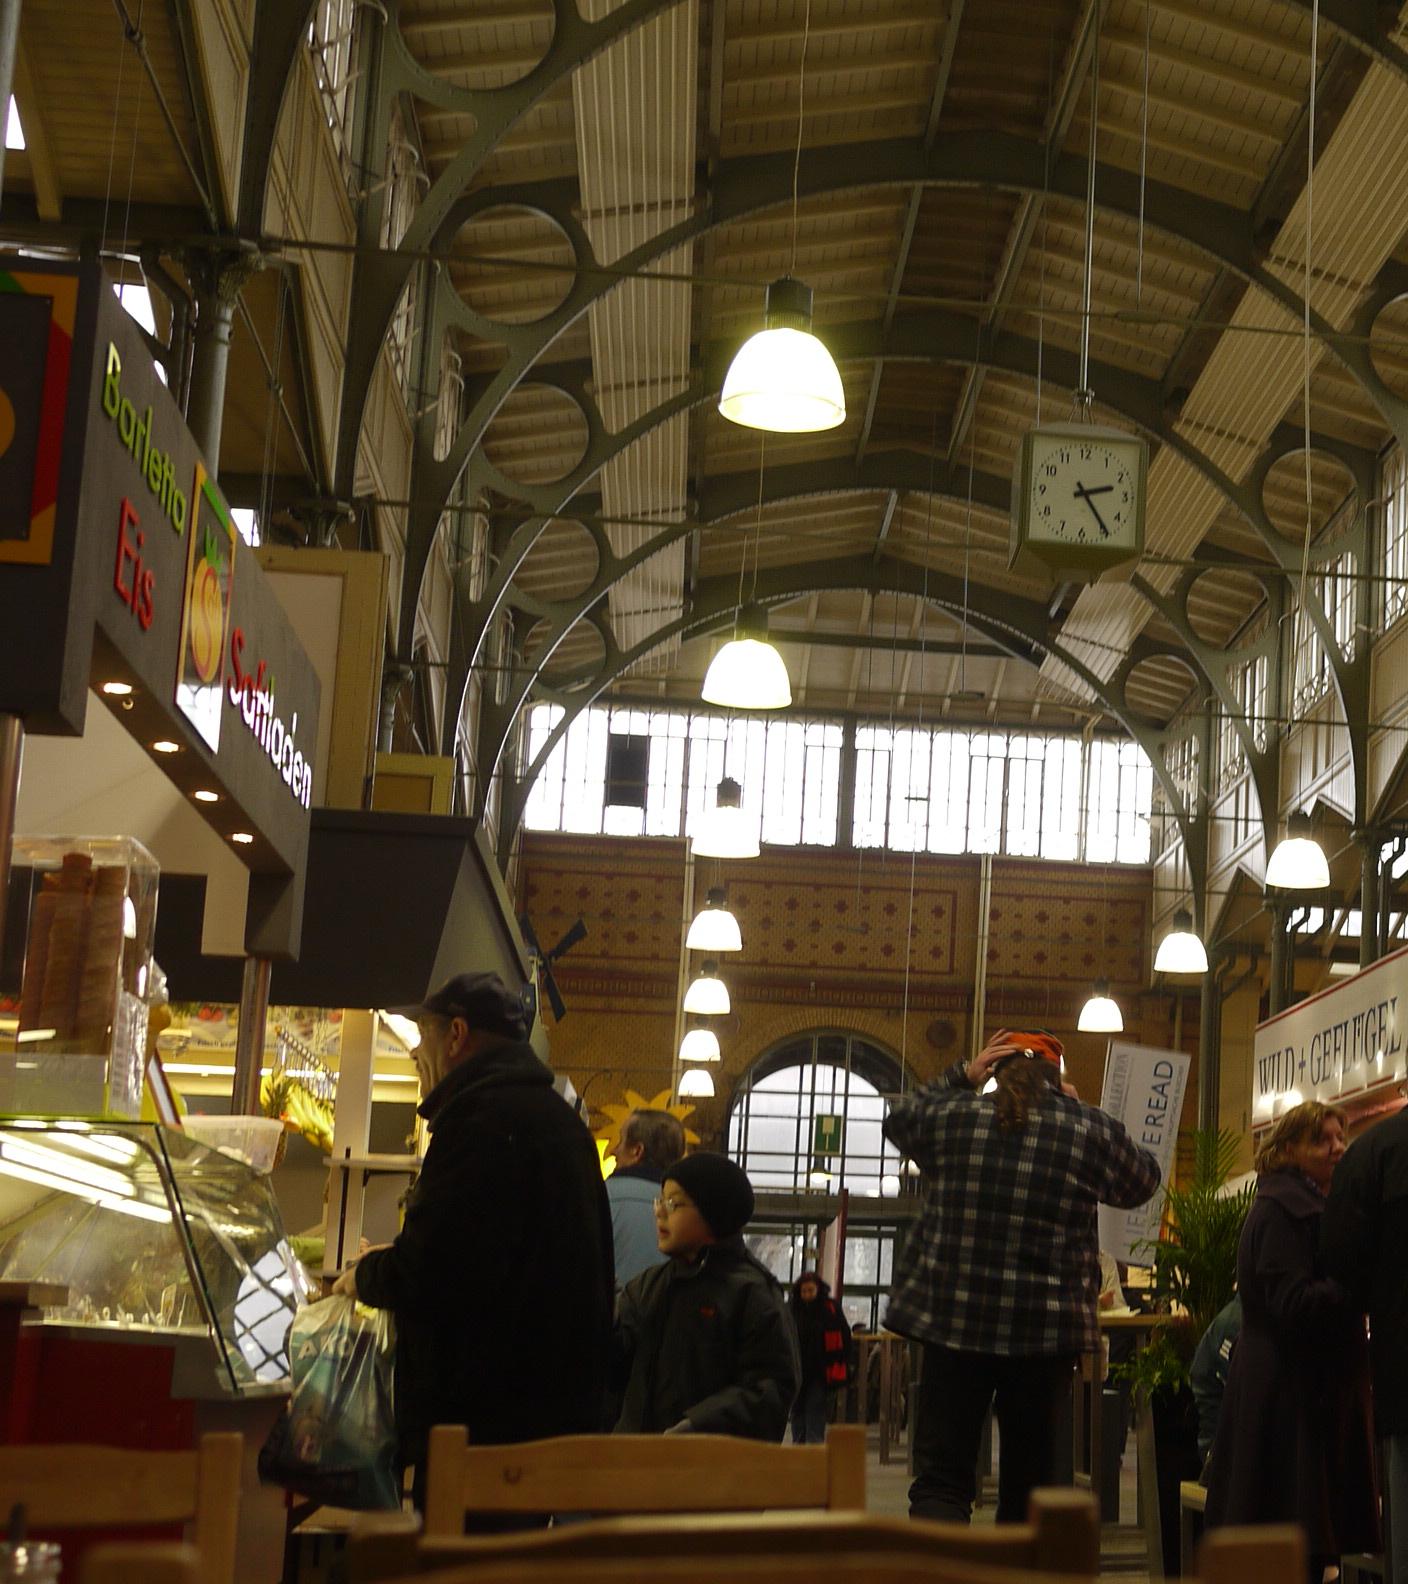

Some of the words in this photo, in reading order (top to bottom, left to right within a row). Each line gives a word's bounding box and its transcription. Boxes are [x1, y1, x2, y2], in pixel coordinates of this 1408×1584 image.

[103, 341, 186, 537] Barletta
[1060, 452, 1070, 464] 11
[1080, 448, 1092, 461] 12
[1105, 457, 1109, 468] 1
[1046, 465, 1057, 477] 10
[1117, 471, 1124, 483] 2
[1039, 484, 1046, 495] 9
[1122, 491, 1128, 503] 3
[1043, 505, 1051, 516] 8
[1114, 511, 1121, 523] 4
[1060, 520, 1066, 532] 7
[1078, 527, 1086, 539] 6
[114, 497, 154, 631] Eis
[227, 627, 313, 810] Saftladen
[1259, 1046, 1295, 1096] WILD
[1310, 996, 1402, 1086] GEFLÜGEL
[1144, 1060, 1174, 1128] READ
